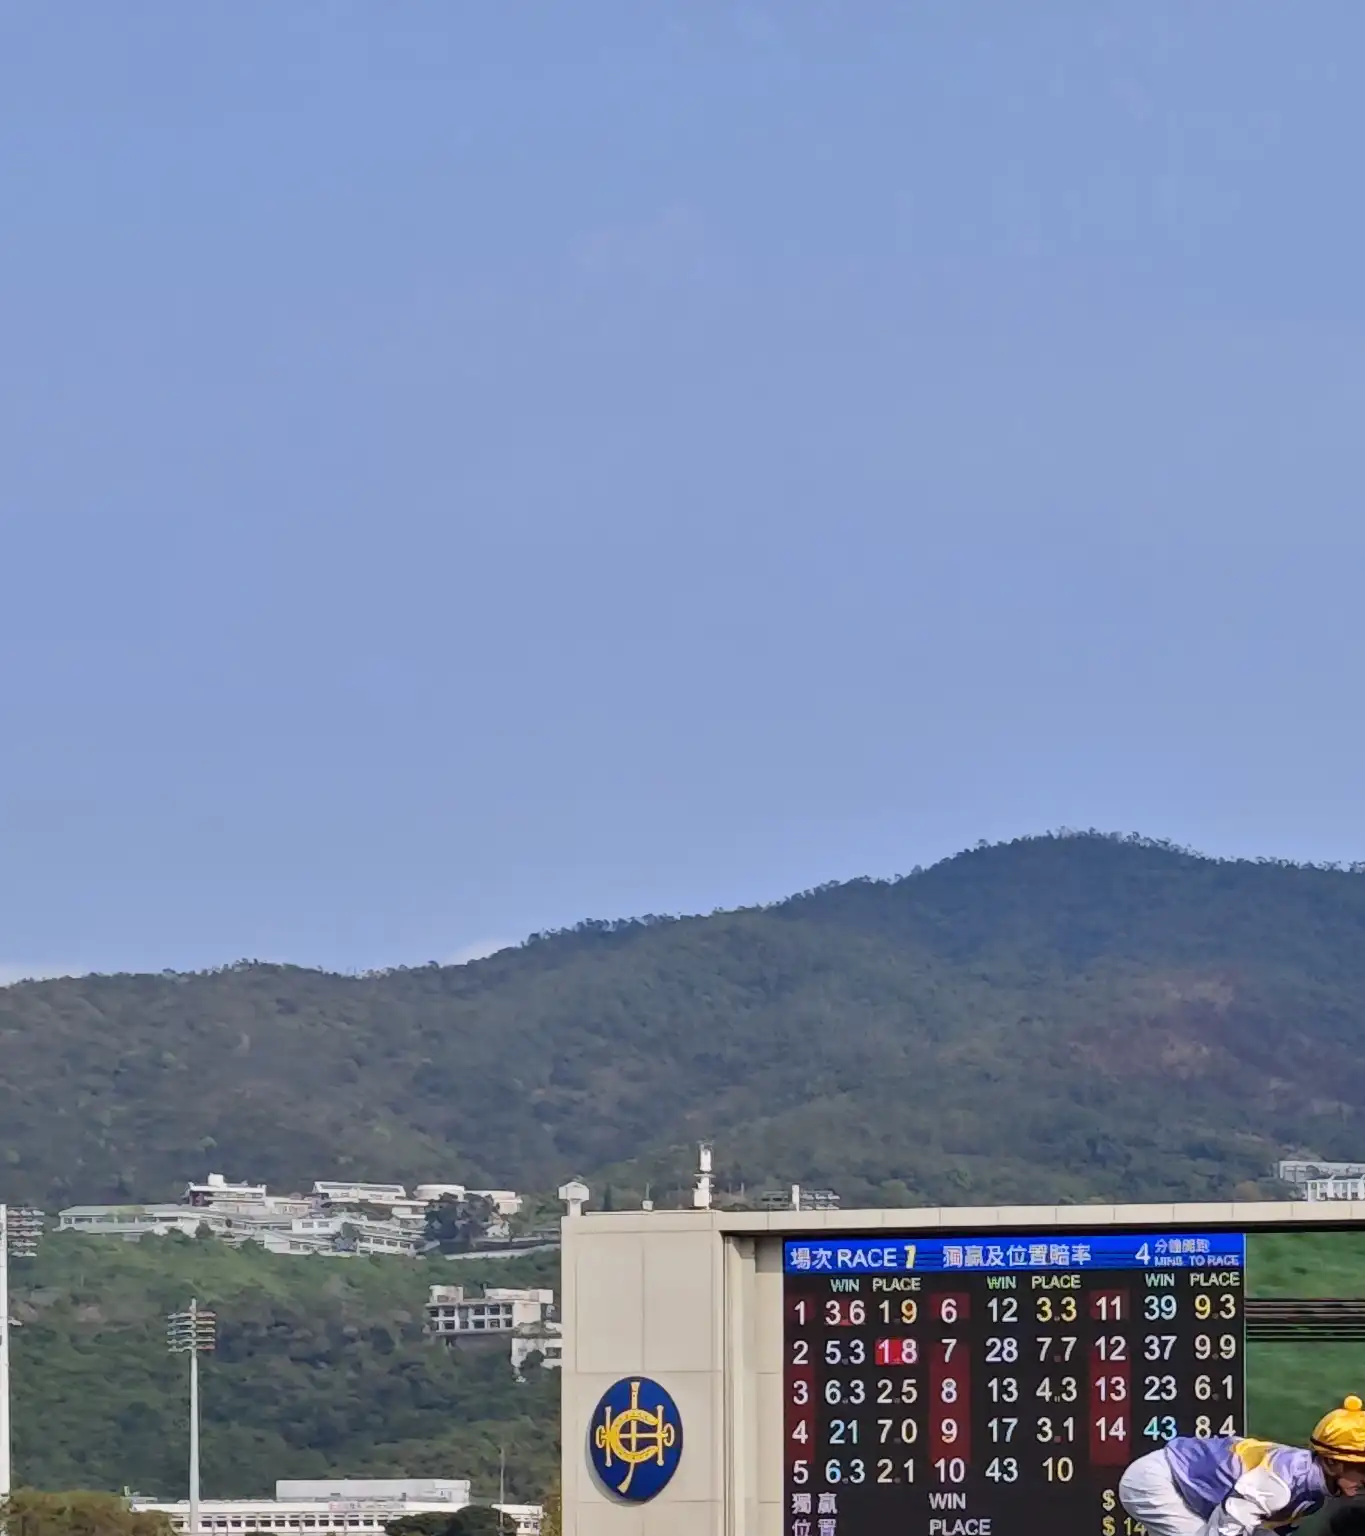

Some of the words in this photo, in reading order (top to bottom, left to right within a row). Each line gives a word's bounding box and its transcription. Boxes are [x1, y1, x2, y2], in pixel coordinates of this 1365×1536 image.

[791, 1248, 832, 1269] 場次
[838, 1248, 897, 1267] RACE
[1135, 1243, 1150, 1265] 4
[1190, 1255, 1205, 1266] TO
[1207, 1255, 1239, 1266] RACE
[831, 1279, 859, 1292] WIN
[873, 1278, 920, 1291] PLACE
[987, 1276, 1016, 1289] WIN
[1032, 1275, 1081, 1289] PLACE
[1145, 1273, 1174, 1287] WIN
[1190, 1272, 1240, 1286] PLACE
[795, 1301, 804, 1325] 1
[826, 1300, 865, 1325] 3.6
[879, 1299, 917, 1323] 1.9
[941, 1299, 957, 1323] 6
[988, 1297, 1017, 1322] 12
[1037, 1297, 1076, 1322] 3.3
[1096, 1296, 1120, 1320] 11
[1145, 1295, 1176, 1320] 39
[1195, 1294, 1235, 1319] 9.3
[793, 1341, 808, 1364] 2
[825, 1340, 865, 1364] 5.3
[879, 1339, 917, 1363] 1.8
[942, 1339, 956, 1362] 7
[986, 1338, 1018, 1362] 28
[1037, 1337, 1077, 1361] 7.7
[1096, 1336, 1125, 1360] 12
[1145, 1335, 1177, 1360] 37
[1195, 1335, 1235, 1359] 9.9
[794, 1381, 808, 1404] 3
[826, 1380, 865, 1404] 6.3
[877, 1379, 917, 1403] 2.5
[942, 1378, 957, 1403] 8
[988, 1378, 1018, 1402] 13
[1036, 1377, 1077, 1402] 4.3
[1096, 1377, 1126, 1401] 13
[1144, 1375, 1177, 1400] 23
[1195, 1375, 1232, 1400] 6.1
[792, 1420, 808, 1444] 4
[830, 1420, 857, 1444] 21
[878, 1419, 917, 1443] 7.0
[942, 1419, 957, 1443] 9
[988, 1418, 1018, 1442] 17
[1037, 1417, 1073, 1442] 3.1
[1096, 1417, 1126, 1441] 14
[1144, 1417, 1177, 1441] 43
[1195, 1415, 1236, 1439] 8.4
[794, 1460, 808, 1484] 5
[826, 1459, 865, 1483] 6.3
[878, 1459, 913, 1483] 2.1
[935, 1458, 964, 1482] 10
[986, 1458, 1018, 1482] 43
[1043, 1457, 1073, 1481] 10
[929, 1493, 965, 1509] WIN
[1103, 1489, 1115, 1511] $
[930, 1519, 991, 1536] PLACE
